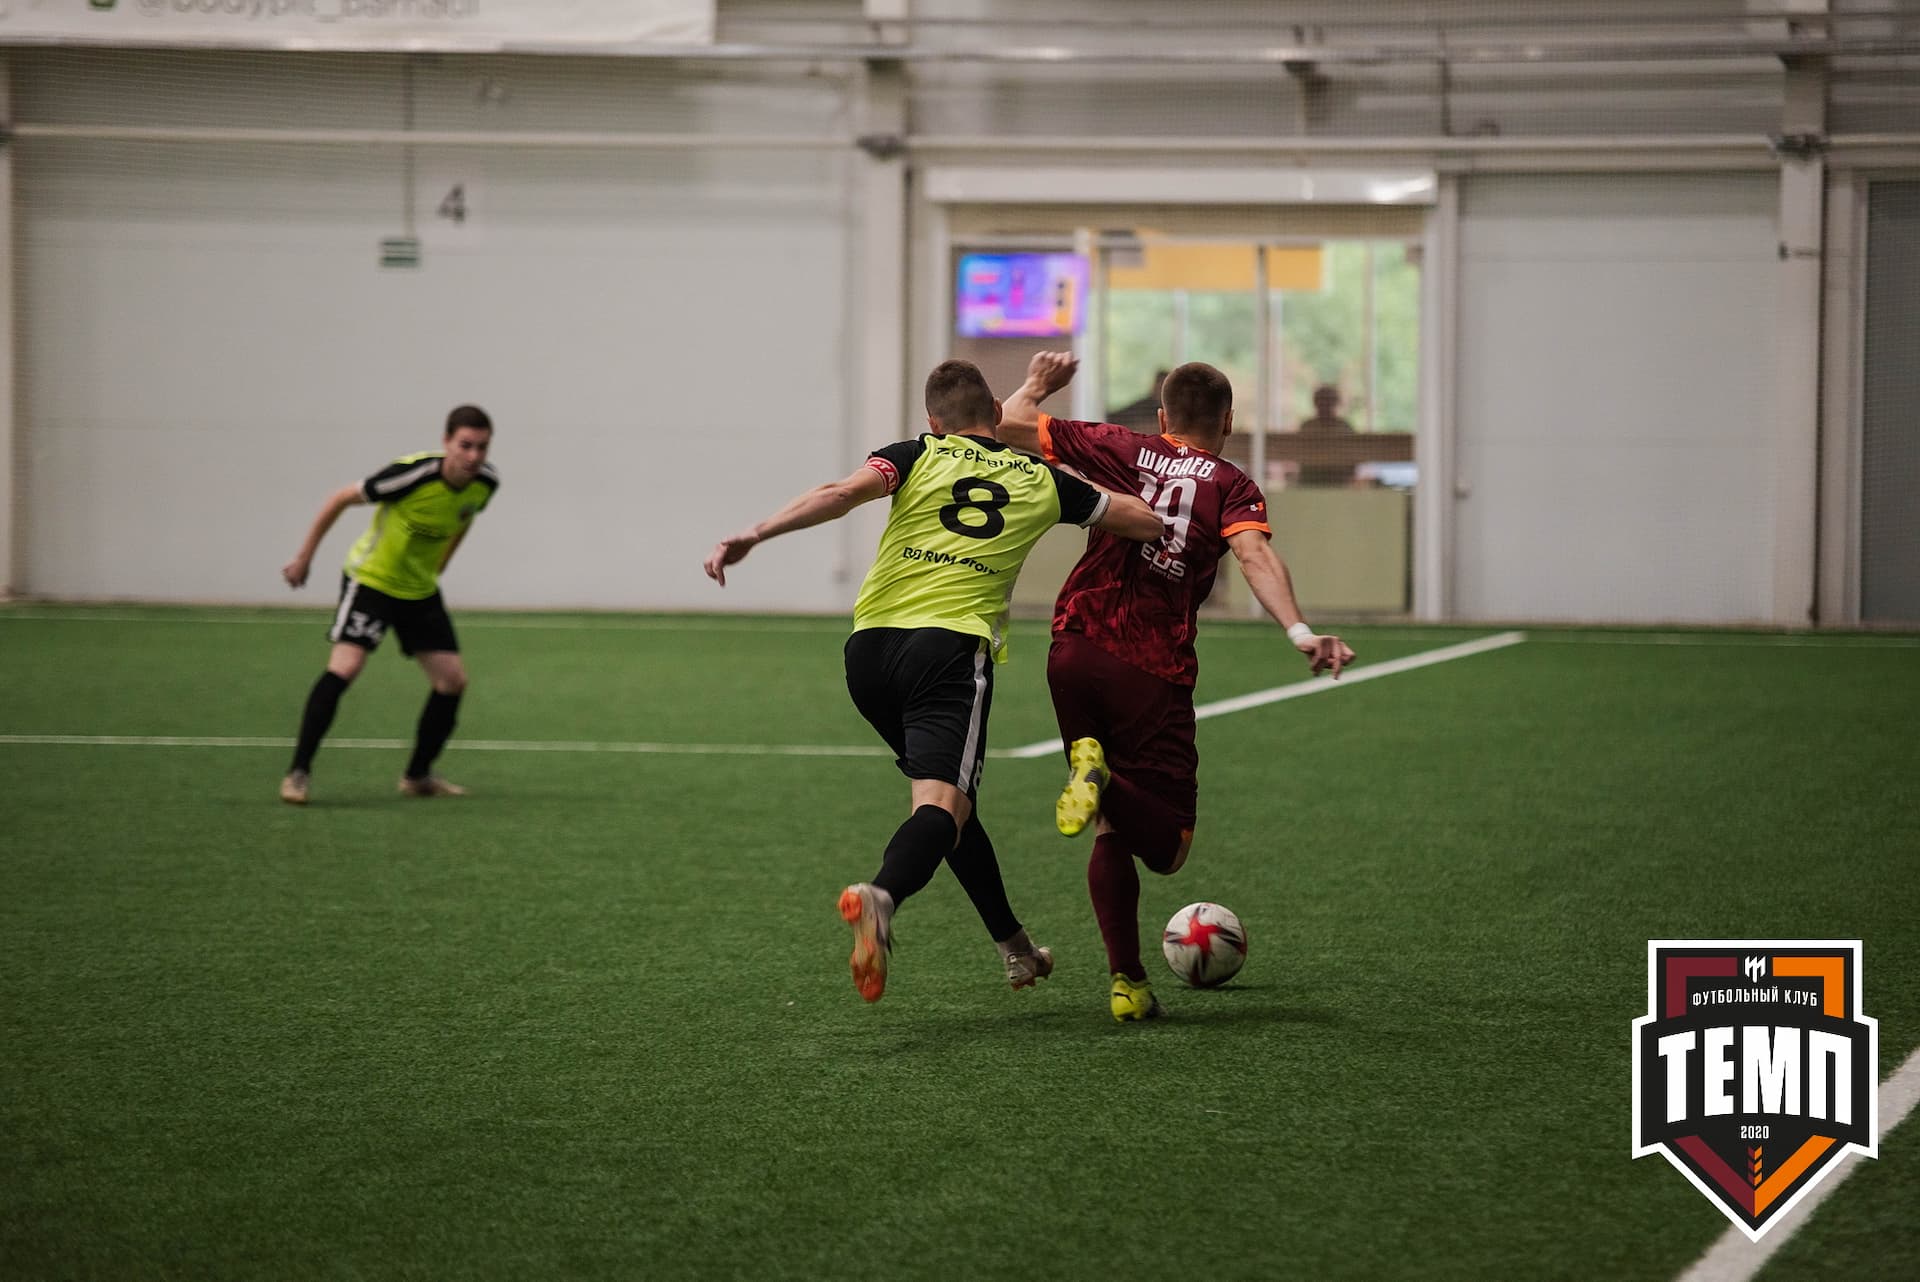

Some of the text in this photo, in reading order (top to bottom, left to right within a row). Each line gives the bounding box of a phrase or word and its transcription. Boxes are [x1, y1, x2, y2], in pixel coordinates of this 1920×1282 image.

[437, 184, 467, 223] 4
[1136, 448, 1216, 478] ШИБАЕВ
[939, 476, 1010, 539] 8
[923, 550, 957, 566] RVM
[1141, 542, 1187, 577] EUS
